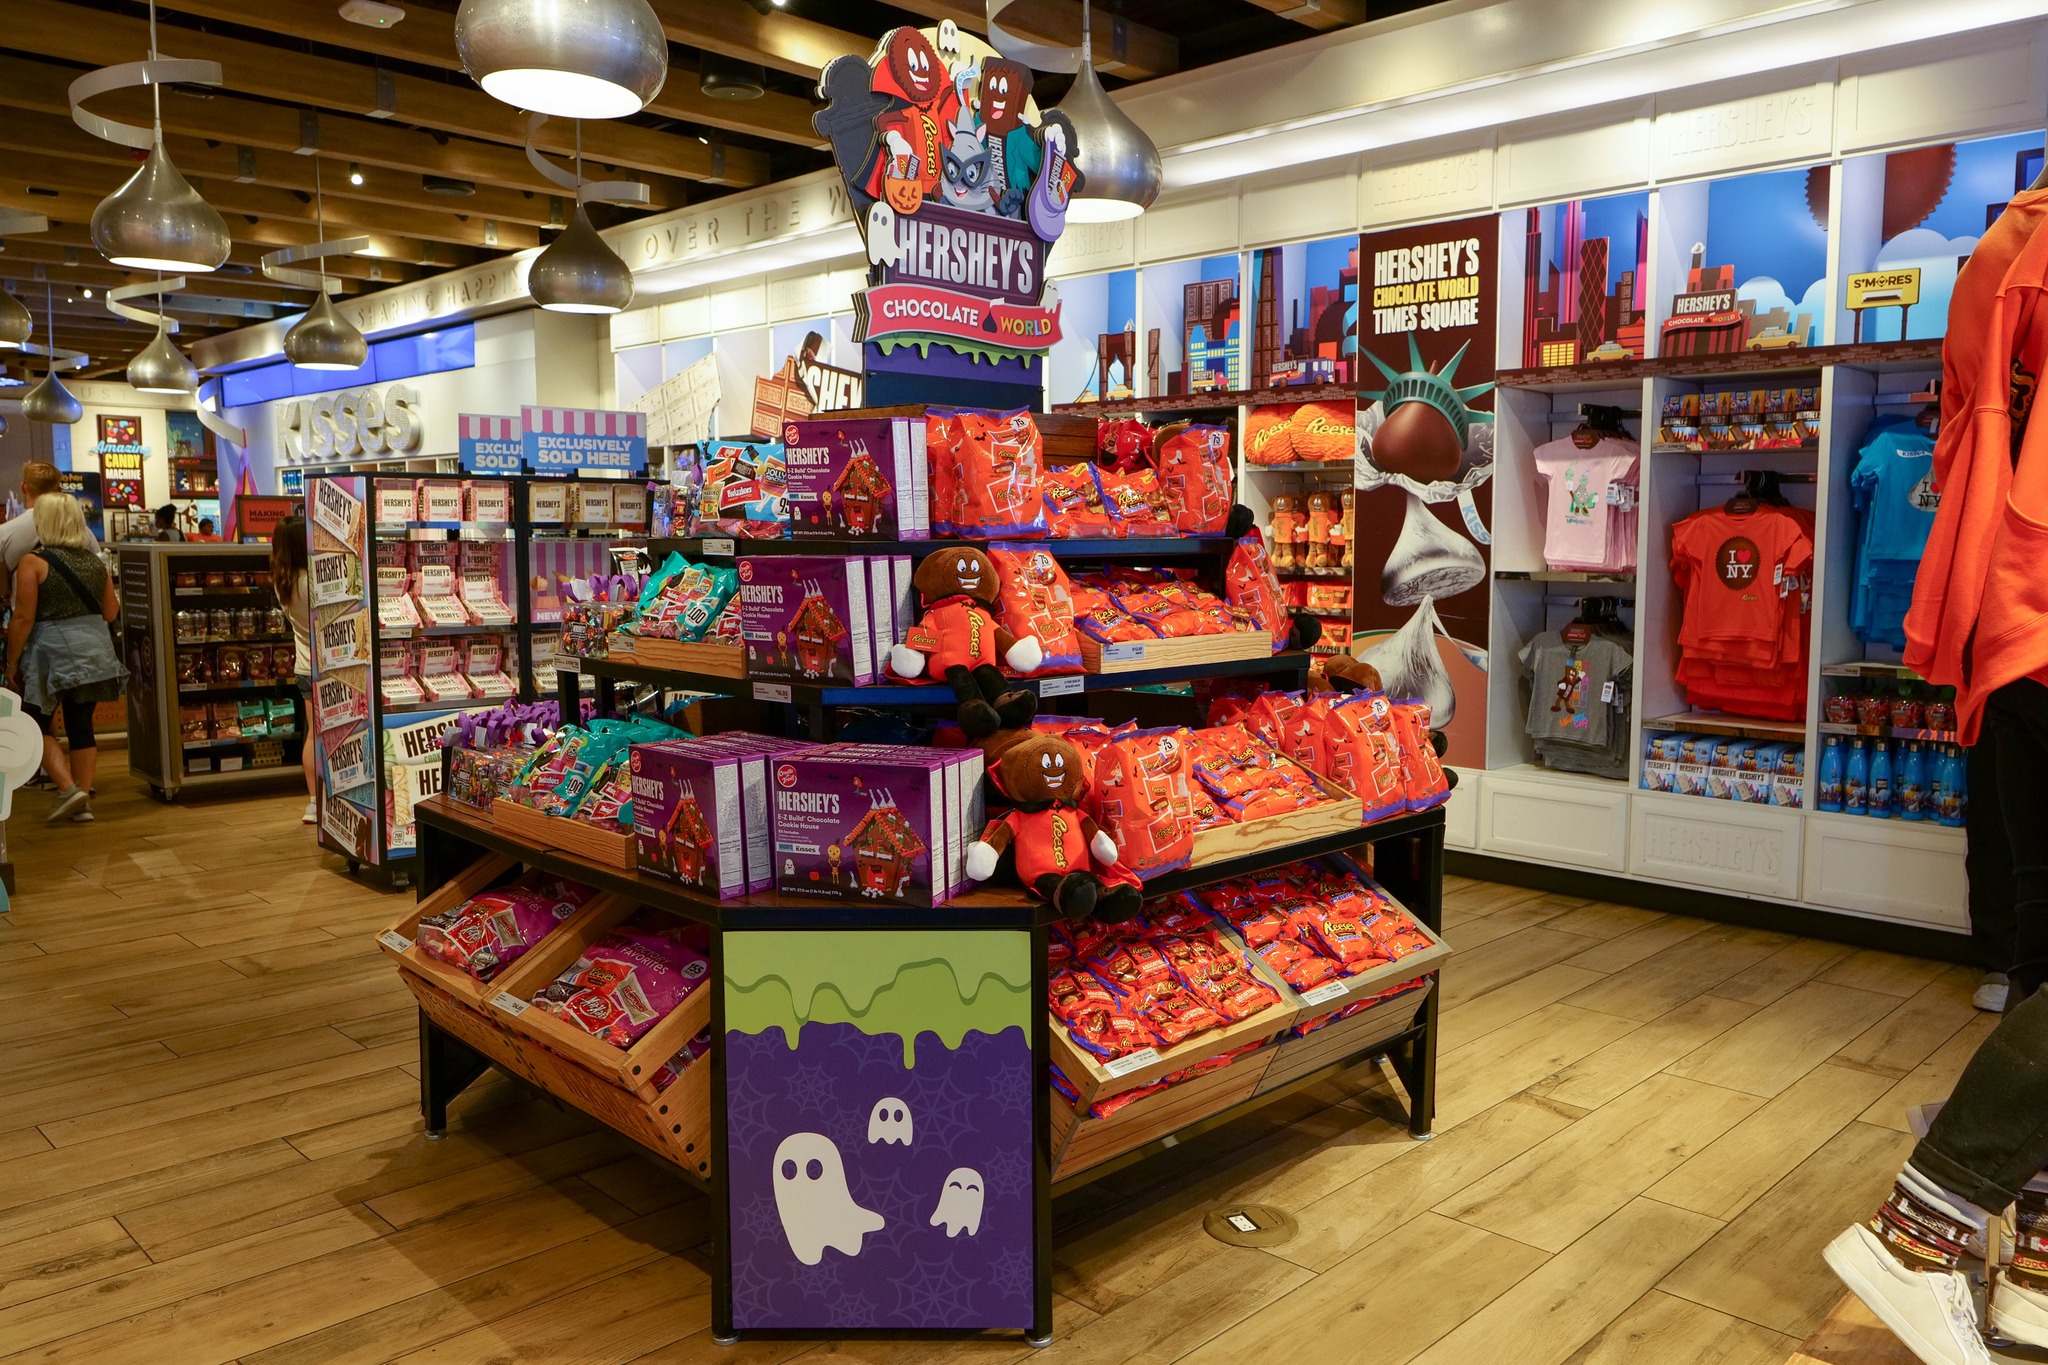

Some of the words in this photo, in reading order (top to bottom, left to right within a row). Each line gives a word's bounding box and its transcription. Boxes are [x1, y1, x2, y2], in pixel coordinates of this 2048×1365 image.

[920, 113, 937, 178] Reese's
[645, 217, 719, 259] OVER
[745, 200, 800, 236] THE
[899, 217, 1034, 295] HERSHEY'S
[1374, 237, 1480, 287] HERSHEY'S
[1373, 280, 1437, 308] CHOCOLATE
[1437, 275, 1480, 300] WORLD
[357, 291, 434, 328] SHARING
[1676, 293, 1731, 315] HERSHEY'S
[882, 298, 980, 327] CHOCOLATE
[1000, 316, 1052, 337] WORLD
[1372, 304, 1419, 335] TIMES
[1420, 297, 1479, 332] SQUARE
[1668, 316, 1705, 326] CHOCOLATE
[1711, 313, 1736, 324] WORLD
[1271, 361, 1298, 373] HERSHEY'S
[1014, 418, 1026, 427] 75
[1304, 416, 1356, 436] Reese
[537, 436, 632, 452] EXCLUSIVELY
[1211, 435, 1222, 446] 75
[91, 439, 153, 462] Amazing
[786, 447, 830, 465] HERSHEY'S
[104, 454, 141, 469] CANDY
[475, 455, 519, 468] SOLD
[537, 450, 584, 465] SOLD
[586, 452, 631, 466] HERE
[105, 469, 142, 481] MACHINE
[765, 467, 787, 480] JOLLY
[1921, 480, 1929, 493] I
[318, 479, 353, 525] HERSHEY'S
[384, 498, 412, 508] HERSHEY'S
[431, 498, 458, 507] HERSHEY'S
[478, 499, 504, 508] HERSHEY'S
[536, 500, 560, 509] HERSHEY'S
[585, 499, 608, 507] HERSHEY'S
[619, 502, 642, 510] HERSHEY'S
[249, 510, 285, 518] MAKING
[1039, 553, 1050, 565] 75
[1728, 550, 1737, 564] I
[314, 553, 348, 584] HERSHEY'S
[378, 570, 406, 579] HERSHEY'S
[423, 569, 450, 577] HERSHEY'S
[740, 584, 784, 604] HERSHEY'S
[760, 605, 785, 613] Chocolate
[536, 611, 561, 621] NEW
[688, 606, 708, 626] 100
[323, 618, 356, 649] HERSHEY'S
[533, 635, 557, 645] HERSHEY'S
[911, 632, 938, 645] Reese's
[967, 609, 985, 660] Reese's
[427, 650, 454, 658] HERSHEY'S
[472, 647, 498, 656] HERSHEY'S
[319, 681, 353, 709] HERSHEY'S
[1163, 737, 1173, 750] 75
[330, 737, 363, 772] HERSHEY'S
[1647, 760, 1671, 771] HERSHEY'S
[1678, 764, 1704, 774] HERSHEY'S
[1711, 767, 1737, 778] HERSHEY'S
[1738, 771, 1765, 782] HERSHEY'S
[567, 776, 585, 795] 100
[1776, 776, 1803, 786] HERSHEY'S
[631, 775, 664, 801] HERSHEY'S
[779, 790, 841, 815] HERSHEY'S
[325, 798, 359, 834] HERSHEY'S
[806, 816, 841, 825] Chocolate
[777, 820, 800, 828] Cookie
[795, 845, 817, 853] kisses
[1051, 814, 1070, 871] Reese's
[1646, 818, 1780, 876] HERSHEY'S
[557, 903, 573, 915] 155
[1323, 919, 1357, 937] Reese's
[631, 942, 671, 965] FACTORY
[587, 966, 617, 982] Reese's
[688, 962, 705, 974] 155
[1112, 1019, 1136, 1029] ASSORTED
